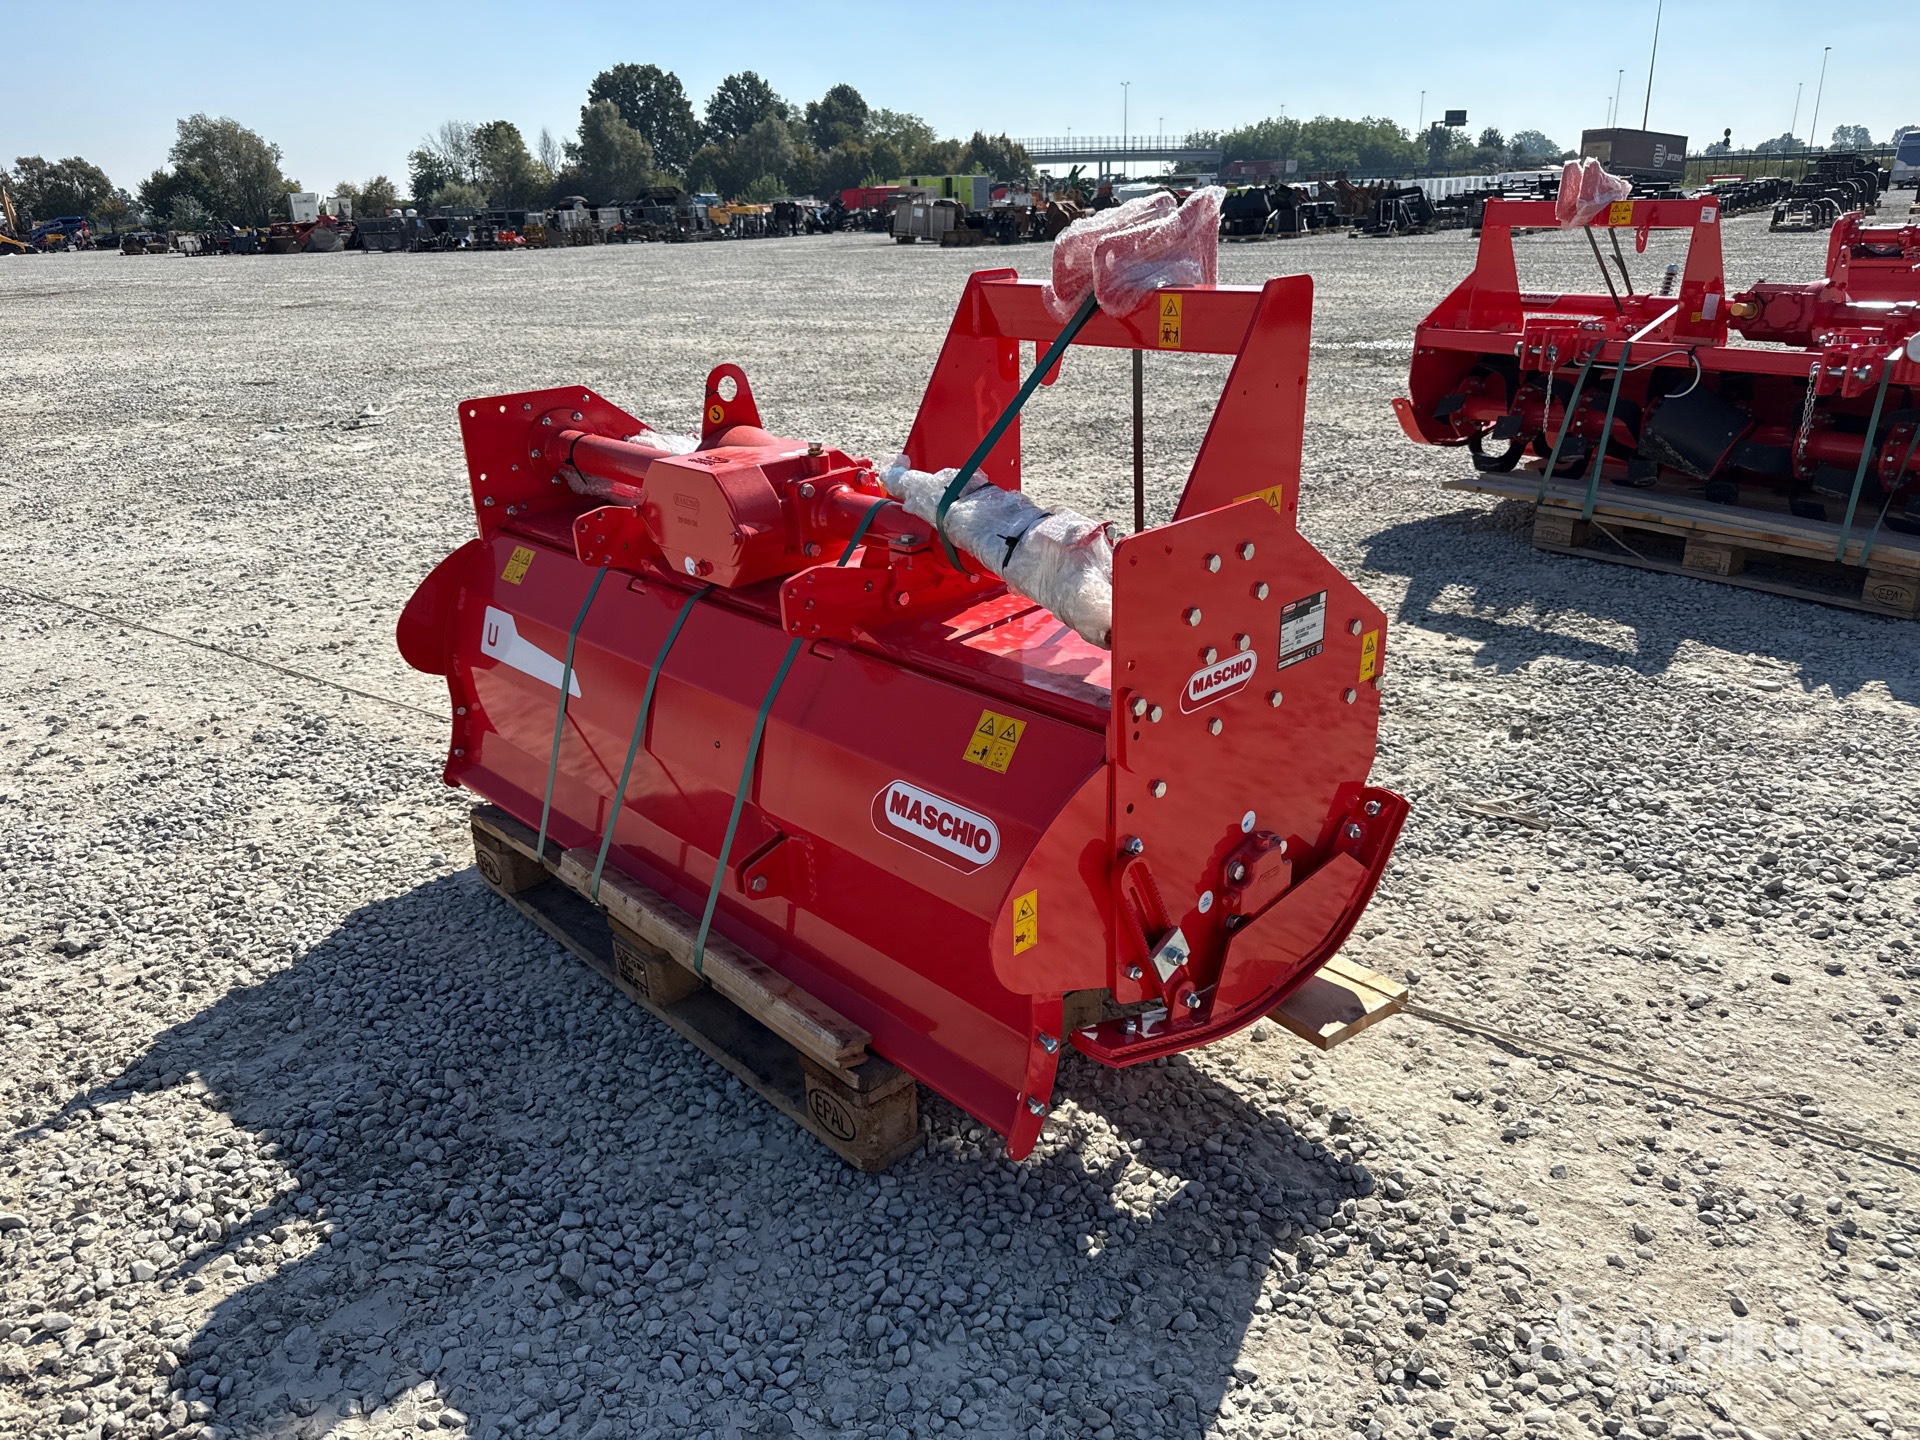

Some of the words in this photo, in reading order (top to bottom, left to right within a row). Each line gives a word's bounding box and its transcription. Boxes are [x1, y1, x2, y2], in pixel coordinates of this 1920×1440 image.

[487, 622, 499, 647] U
[1192, 657, 1252, 695] MASCHIO
[889, 790, 992, 854] MASCHIO
[815, 1092, 850, 1138] EPAL
